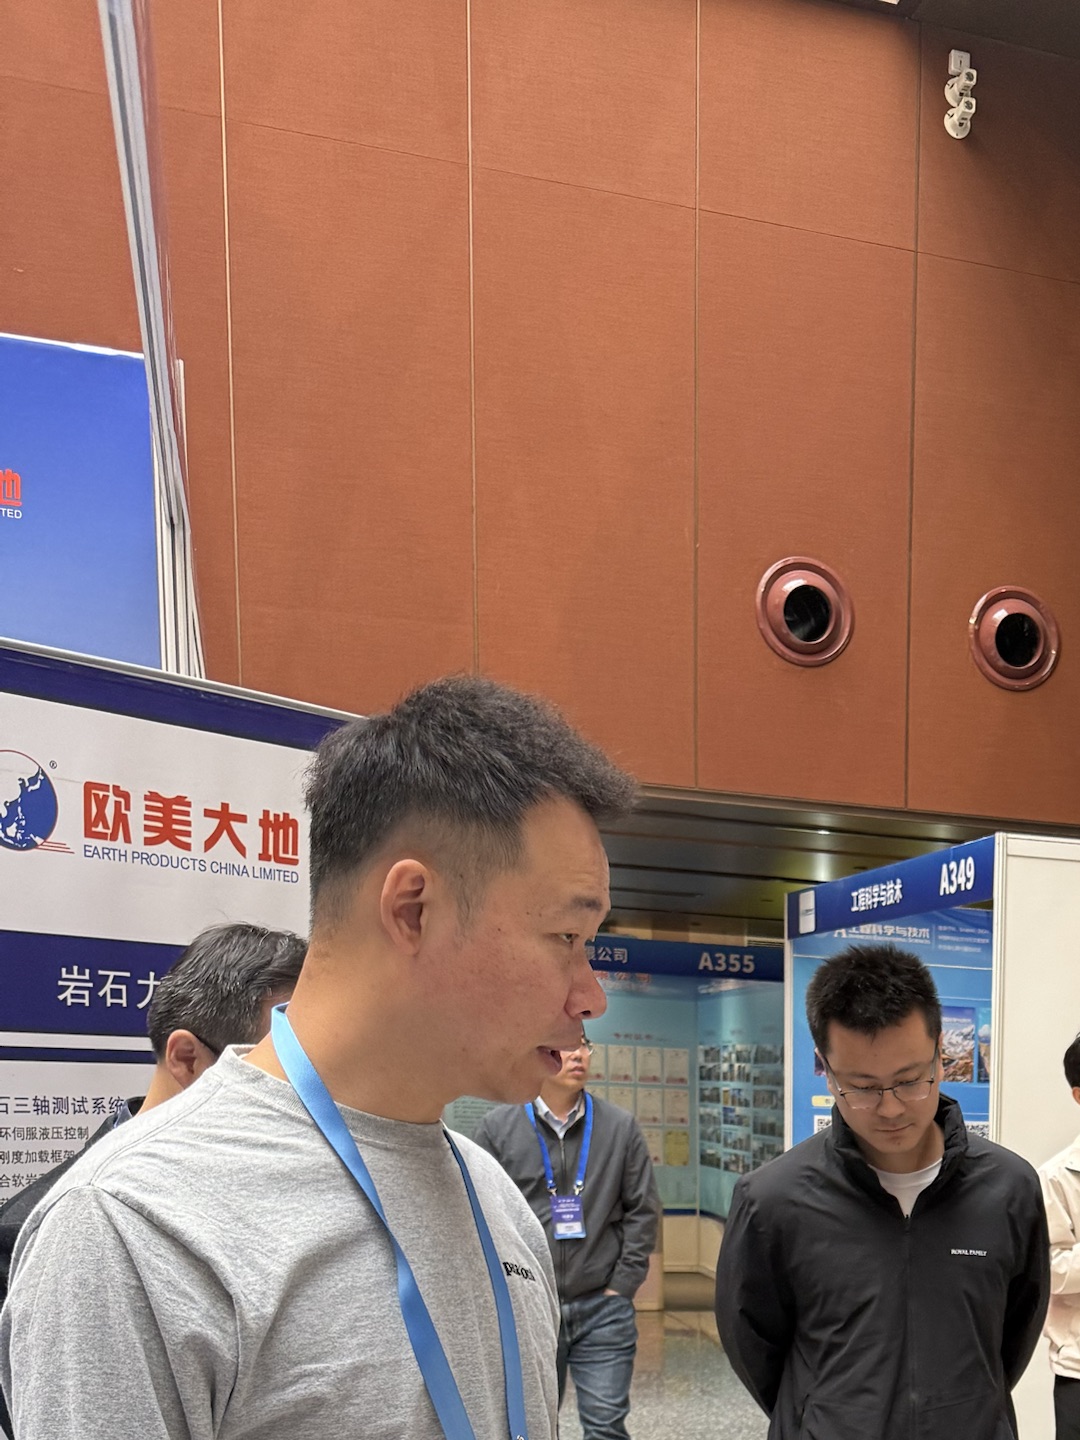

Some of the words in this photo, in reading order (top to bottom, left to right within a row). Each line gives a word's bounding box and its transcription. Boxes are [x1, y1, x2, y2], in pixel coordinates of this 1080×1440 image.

[83, 781, 299, 866] 欧美大地
[83, 844, 128, 863] EARTH
[131, 851, 207, 872] PRODUCTS
[210, 860, 250, 878] CHINA
[252, 866, 299, 884] LIMITED
[851, 878, 903, 912] 工程科学与技术
[939, 856, 975, 896] A349
[698, 952, 755, 973] A355
